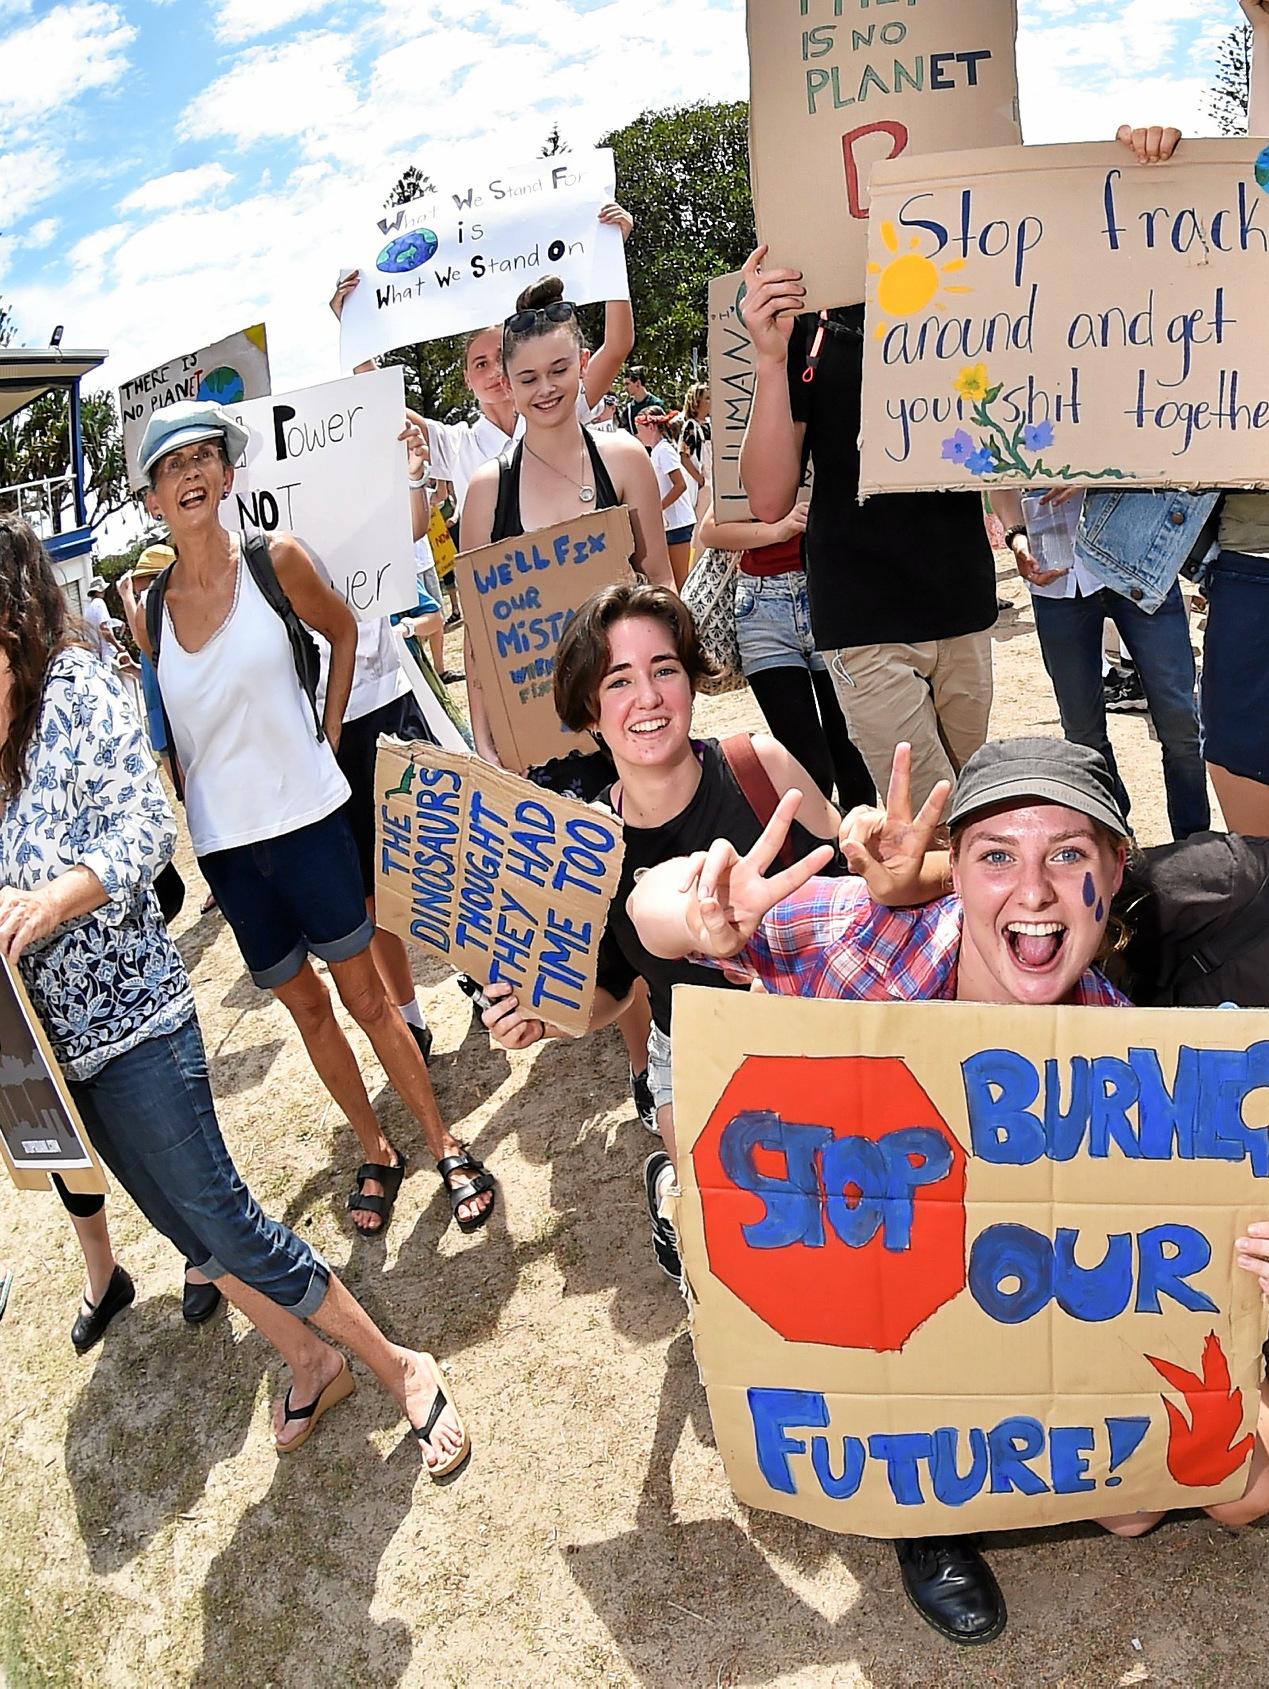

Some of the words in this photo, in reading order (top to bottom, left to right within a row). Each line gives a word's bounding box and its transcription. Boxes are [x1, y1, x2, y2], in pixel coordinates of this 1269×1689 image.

[801, 25, 837, 61] IS
[852, 20, 908, 51] NO
[806, 49, 992, 115] PLANET
[452, 188, 483, 210] We
[489, 179, 542, 200] Stand
[551, 166, 583, 189] For
[458, 221, 484, 243] is
[899, 189, 1043, 287] Stop
[376, 277, 425, 309] What
[435, 266, 461, 287] We
[471, 244, 540, 278] Stand
[548, 239, 585, 262] On
[883, 284, 1038, 365] around
[121, 367, 170, 400] THERE
[182, 352, 199, 372] IS
[1002, 368, 1081, 425] shit
[123, 404, 143, 424] NO
[272, 405, 364, 462] Power
[236, 483, 301, 531] NOT
[474, 545, 550, 595] WE'LL
[553, 533, 607, 566] FIX
[493, 586, 541, 620] OUR
[381, 805, 412, 876] THE
[411, 767, 462, 953] DINOSAURS
[456, 791, 509, 951] THOUGHT
[506, 800, 557, 888] HAD
[552, 818, 616, 896] TOO
[488, 888, 539, 989] THEY
[532, 907, 592, 1010] TIME
[719, 1110, 954, 1251] STOP
[968, 1222, 1221, 1325] OUR
[747, 1387, 1151, 1507] FUTURE!
